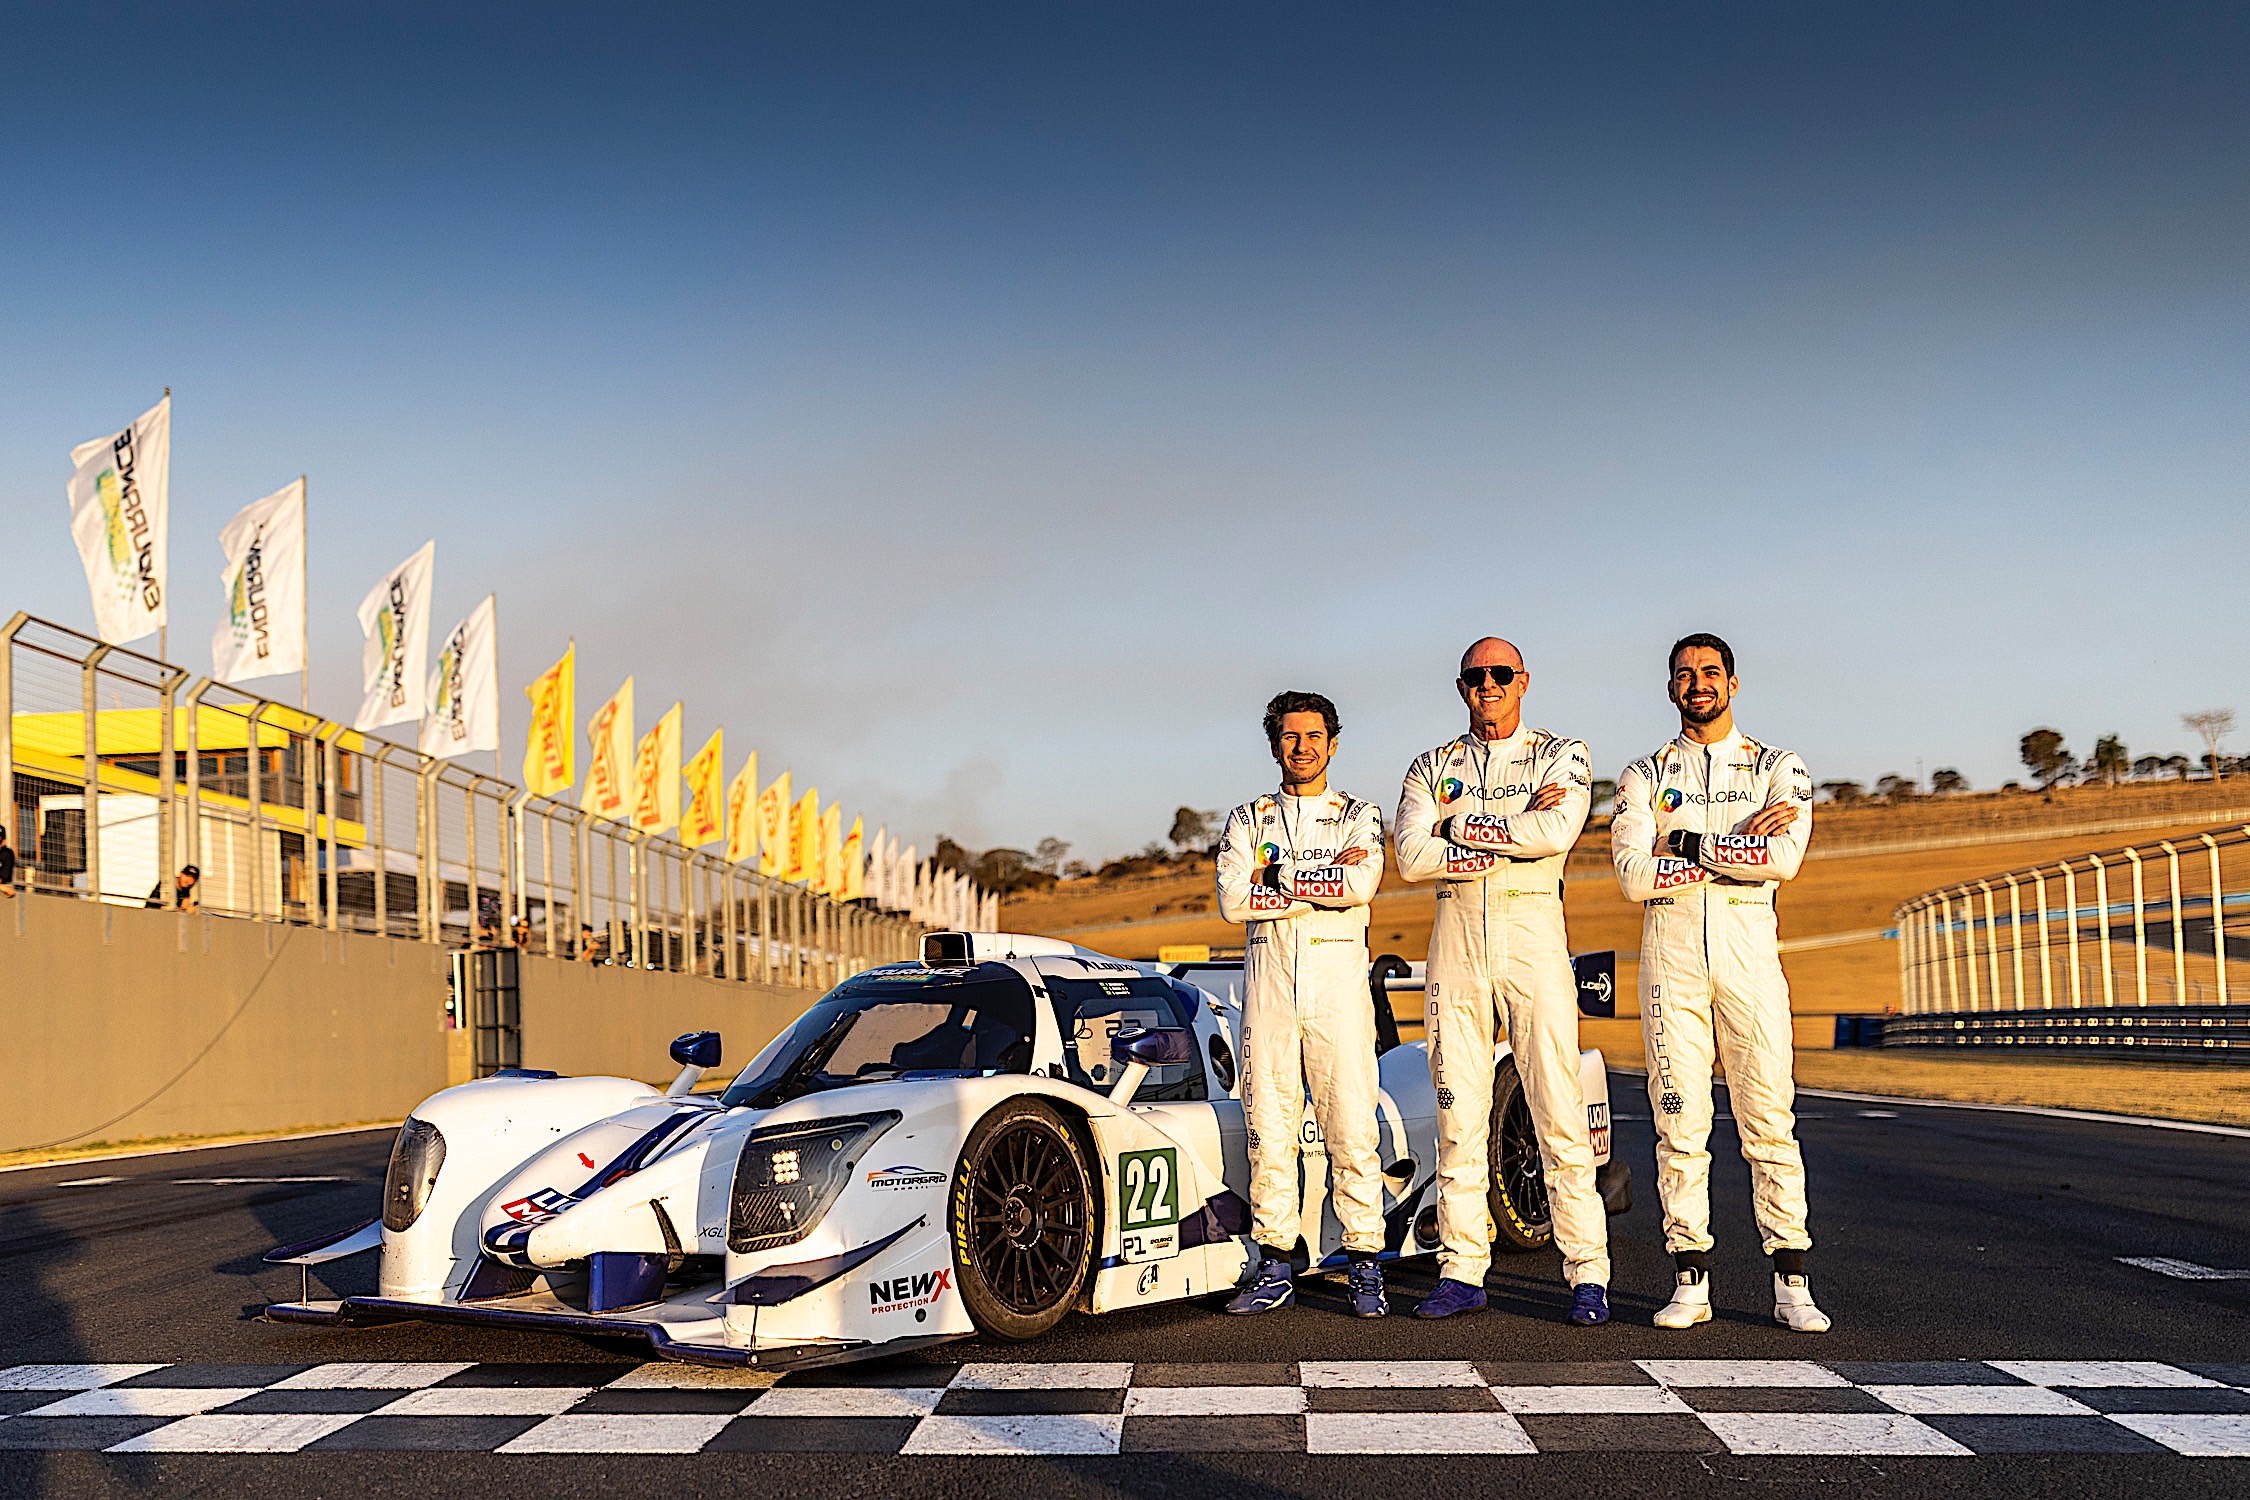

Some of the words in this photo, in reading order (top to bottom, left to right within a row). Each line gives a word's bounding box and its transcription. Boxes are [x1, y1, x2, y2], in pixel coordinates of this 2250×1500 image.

[1686, 791, 1757, 805] XGLOBAL
[1466, 826, 1509, 843] MOLY
[1717, 835, 1766, 849] LIQUI
[1449, 855, 1493, 872] MOLY
[1716, 847, 1767, 864] MOLY
[1296, 868, 1342, 882] LIQUI
[1656, 867, 1706, 889] MOLY
[1296, 882, 1343, 896] MOLY
[1252, 896, 1289, 909] MOL
[1651, 984, 1674, 1089] AUTLOG
[871, 1174, 947, 1188] MOTORGRID
[1126, 1155, 1172, 1225] 22
[505, 1201, 557, 1224] MO
[955, 1158, 972, 1266] PIRELLI
[1122, 1236, 1147, 1259] P1
[869, 1267, 952, 1305] NEWX
[871, 1297, 929, 1314] PROTECTION
